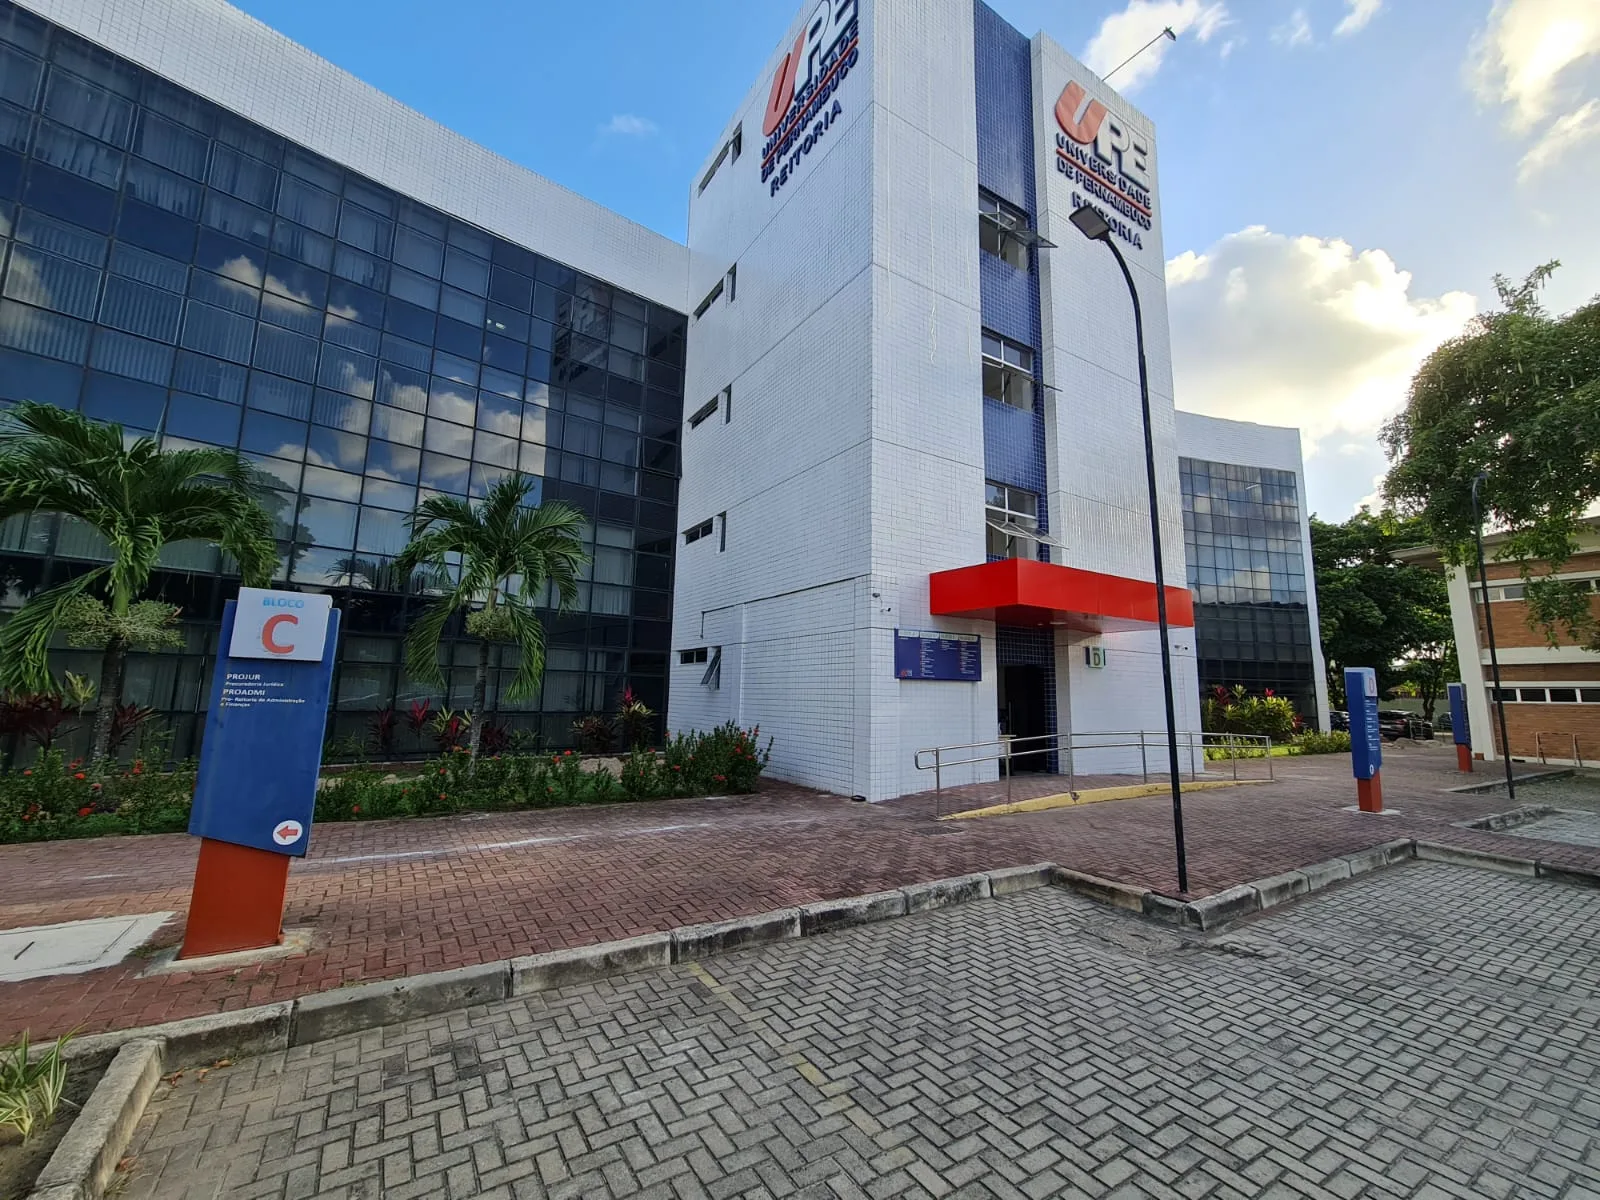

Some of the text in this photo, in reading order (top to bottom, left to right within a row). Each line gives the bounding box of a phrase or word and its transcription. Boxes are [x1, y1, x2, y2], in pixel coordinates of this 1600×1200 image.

[761, 47, 859, 184] DE PERNAMBUCO
[762, 19, 859, 159] UNIVERSIDADE
[770, 99, 843, 198] REITORIA
[1054, 79, 1151, 193] UPE
[1057, 156, 1152, 231] DE PERNAMBUCO
[262, 614, 299, 655] C
[263, 597, 305, 609] BLOCO
[223, 688, 266, 696] PROADMI
[226, 673, 261, 681] PROJUR
